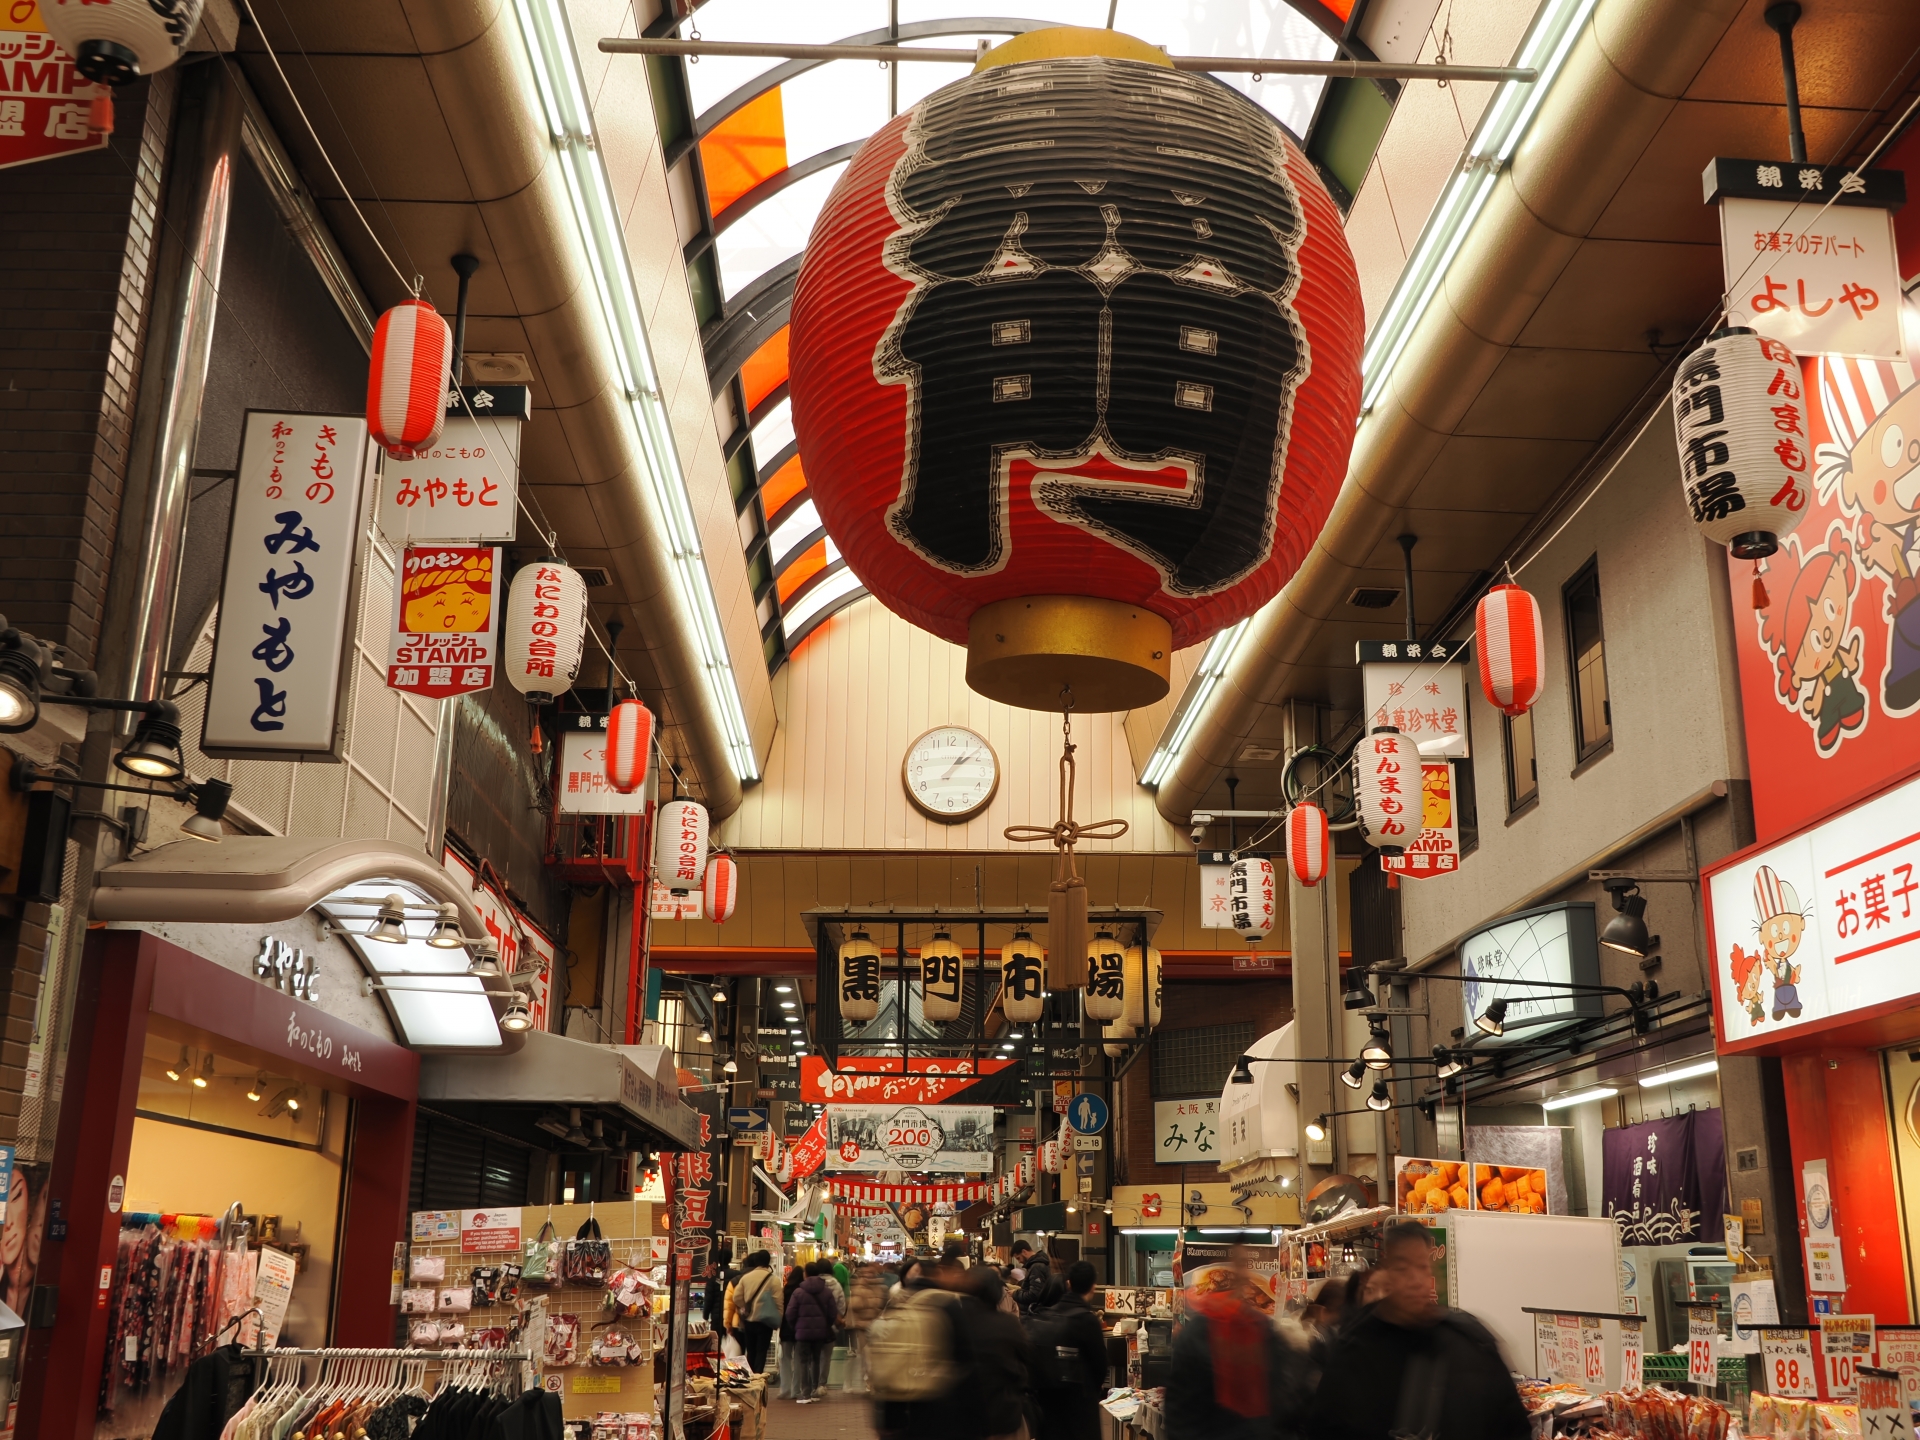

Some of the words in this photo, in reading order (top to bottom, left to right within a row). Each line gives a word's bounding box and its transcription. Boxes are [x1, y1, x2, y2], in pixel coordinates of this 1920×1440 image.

[1753, 230, 1865, 259] お菓子のデパート
[1750, 275, 1879, 321] よしや
[1755, 337, 1807, 512] ほんまもん
[1674, 347, 1745, 522] 黒門市場
[266, 421, 293, 499] 和のこもの
[305, 424, 338, 504] きもの
[396, 476, 499, 508] みやもと
[406, 552, 464, 574] クロモン
[250, 510, 321, 732] みやもと
[525, 566, 562, 678] なにわの台所
[406, 633, 477, 647] フレッシュ
[396, 647, 487, 664] STAMP
[1382, 644, 1447, 658] 親栄会
[394, 667, 487, 686] 加盟店
[1388, 682, 1441, 697] 珍味
[932, 740, 940, 750] 11
[946, 735, 957, 747] 12
[920, 750, 929, 762] 10
[975, 751, 982, 762] 2
[916, 765, 923, 776] 9
[979, 766, 986, 777] 3
[919, 780, 928, 792] 8
[973, 781, 982, 792] 4
[1374, 737, 1405, 836] ほんまもん
[932, 792, 940, 803] 7
[947, 796, 954, 808] 6
[962, 792, 969, 804] 5
[676, 804, 699, 881] なにわの台所
[1387, 854, 1454, 869] 加盟店
[1208, 893, 1228, 913] 京
[1229, 861, 1252, 930] 黒門市場
[1259, 860, 1274, 931] ほんまもん
[1835, 862, 1920, 940] お菓子
[842, 954, 880, 1002] 黒
[922, 955, 961, 1002] 門
[1003, 952, 1043, 1001] 市
[286, 1011, 333, 1060] 和のこもの
[893, 1119, 928, 1129] 黒門市場
[888, 1128, 931, 1147] 200
[1163, 1121, 1215, 1153] みな
[842, 1144, 858, 1159] 祝
[1049, 1142, 1059, 1173] ほんまもん
[1647, 1131, 1658, 1176] 珍味
[1186, 1247, 1227, 1257] Kuromon
